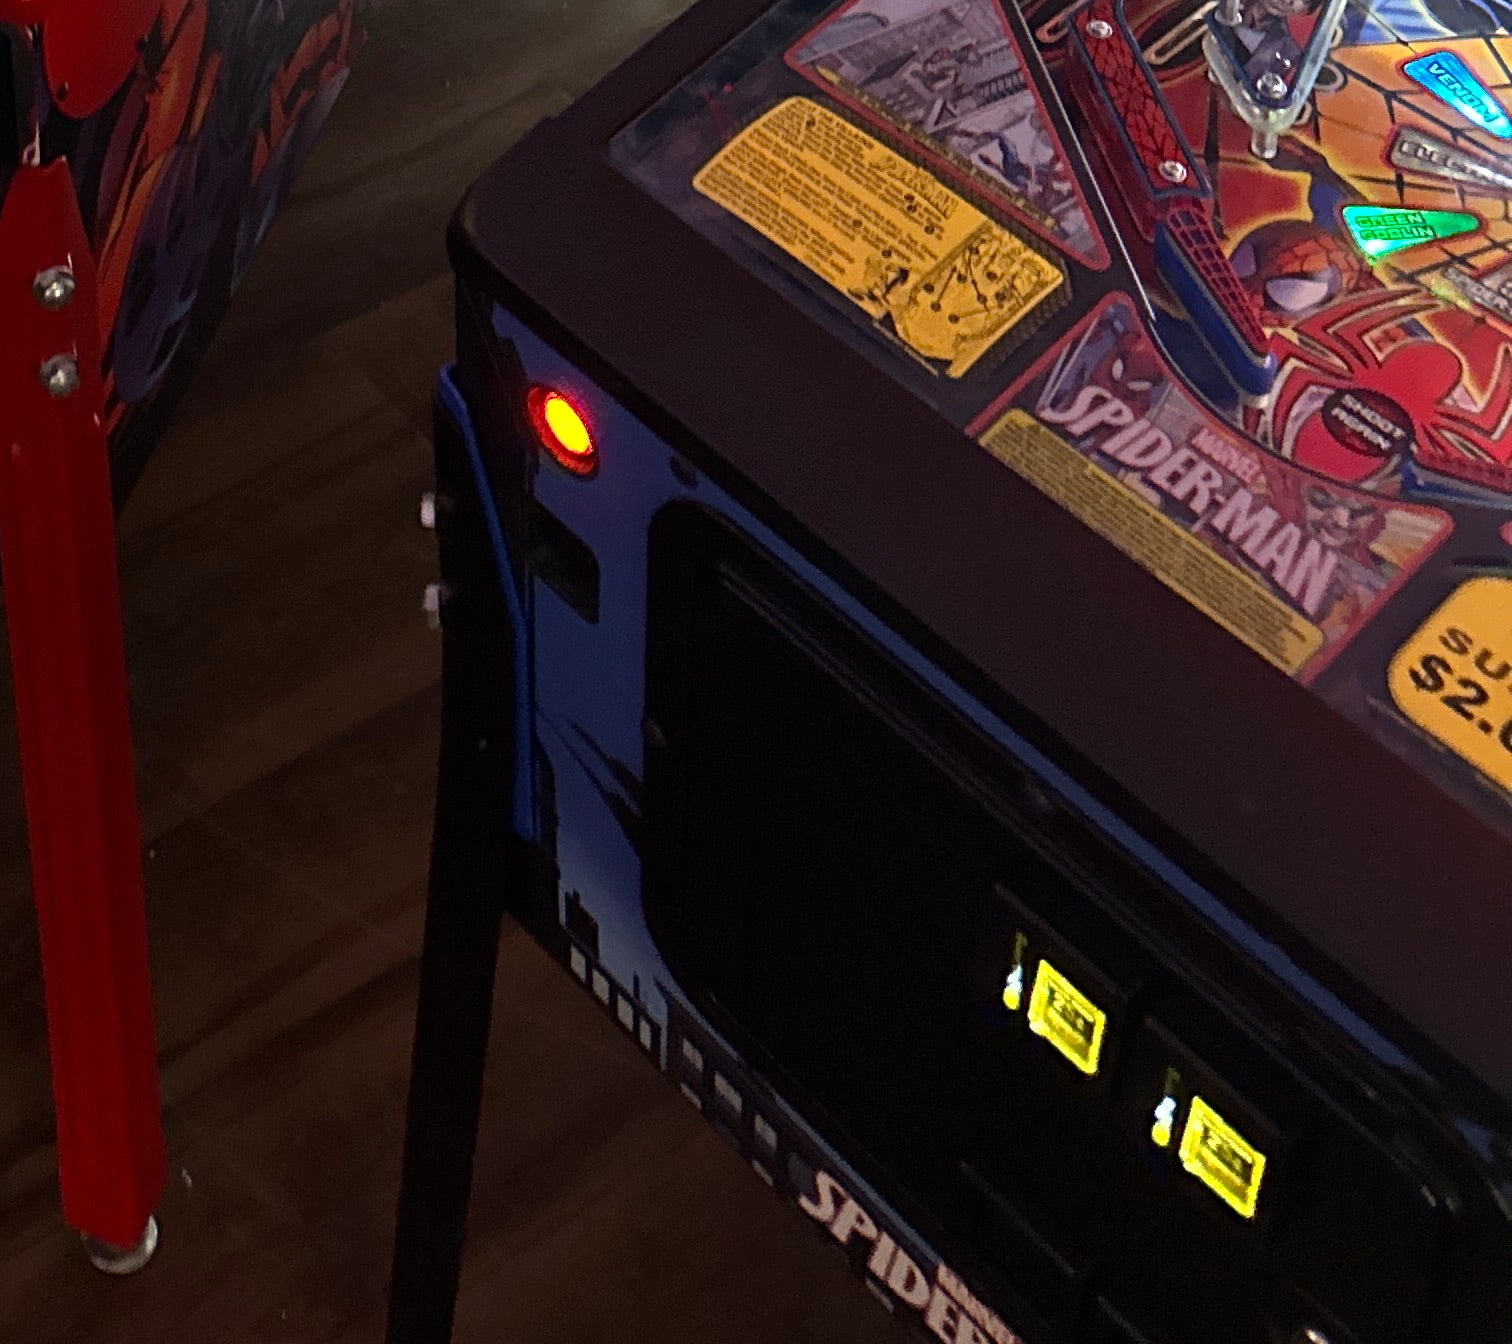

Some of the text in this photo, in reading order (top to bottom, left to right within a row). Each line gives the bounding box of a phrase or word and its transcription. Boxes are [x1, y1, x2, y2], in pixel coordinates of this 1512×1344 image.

[1428, 63, 1500, 124] VENOM
[1355, 212, 1425, 227] GREEN
[1359, 226, 1436, 241] GOBLIN
[1038, 383, 1339, 616] SPIDER-MAN
[1438, 627, 1512, 690] SU
